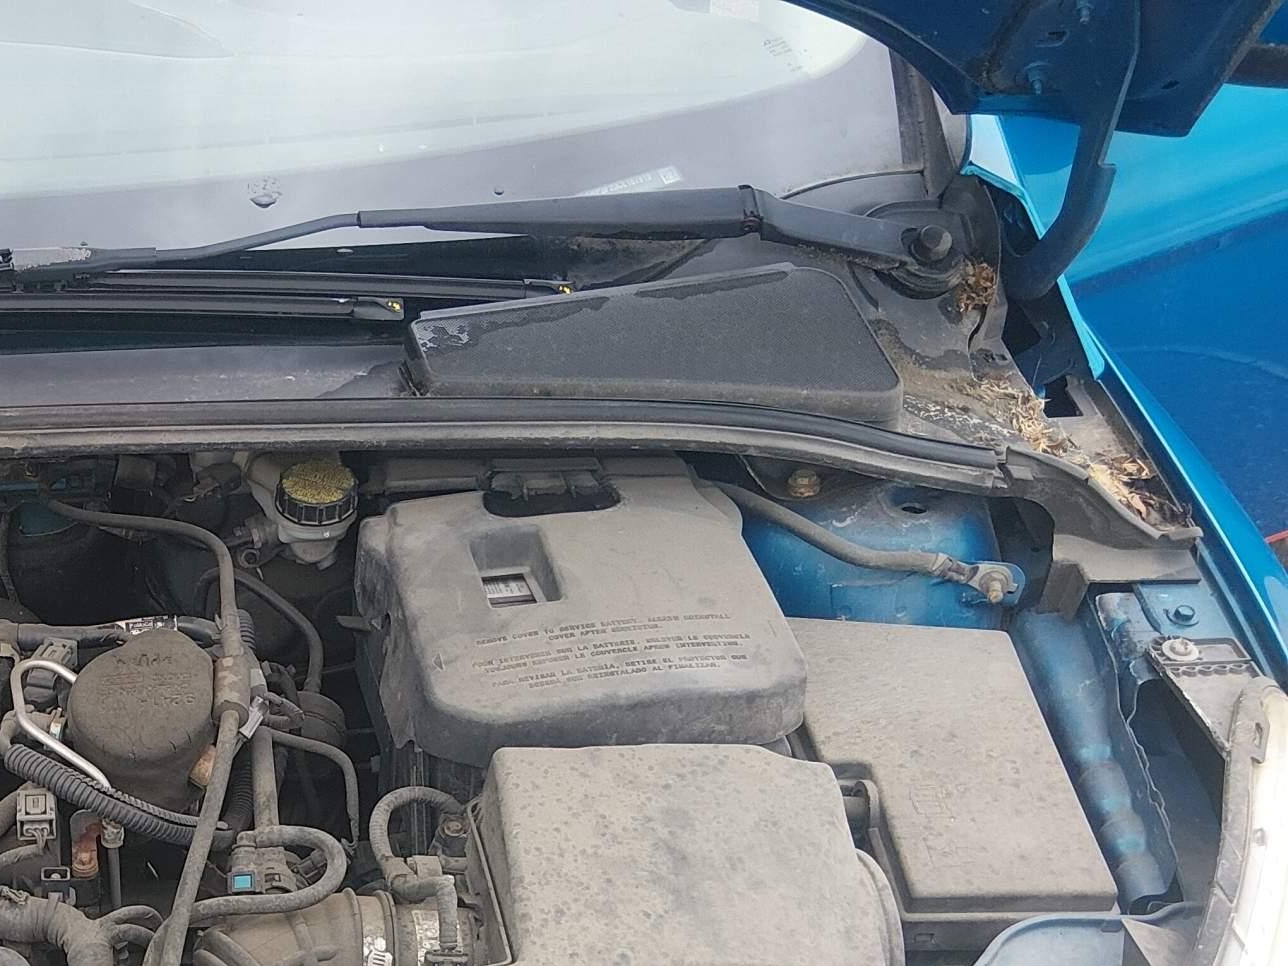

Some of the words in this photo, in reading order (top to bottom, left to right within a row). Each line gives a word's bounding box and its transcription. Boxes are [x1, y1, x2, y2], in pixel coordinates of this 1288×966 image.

[512, 630, 539, 639] COVER
[549, 632, 575, 640] COVER
[591, 646, 637, 657] COUVERCLE
